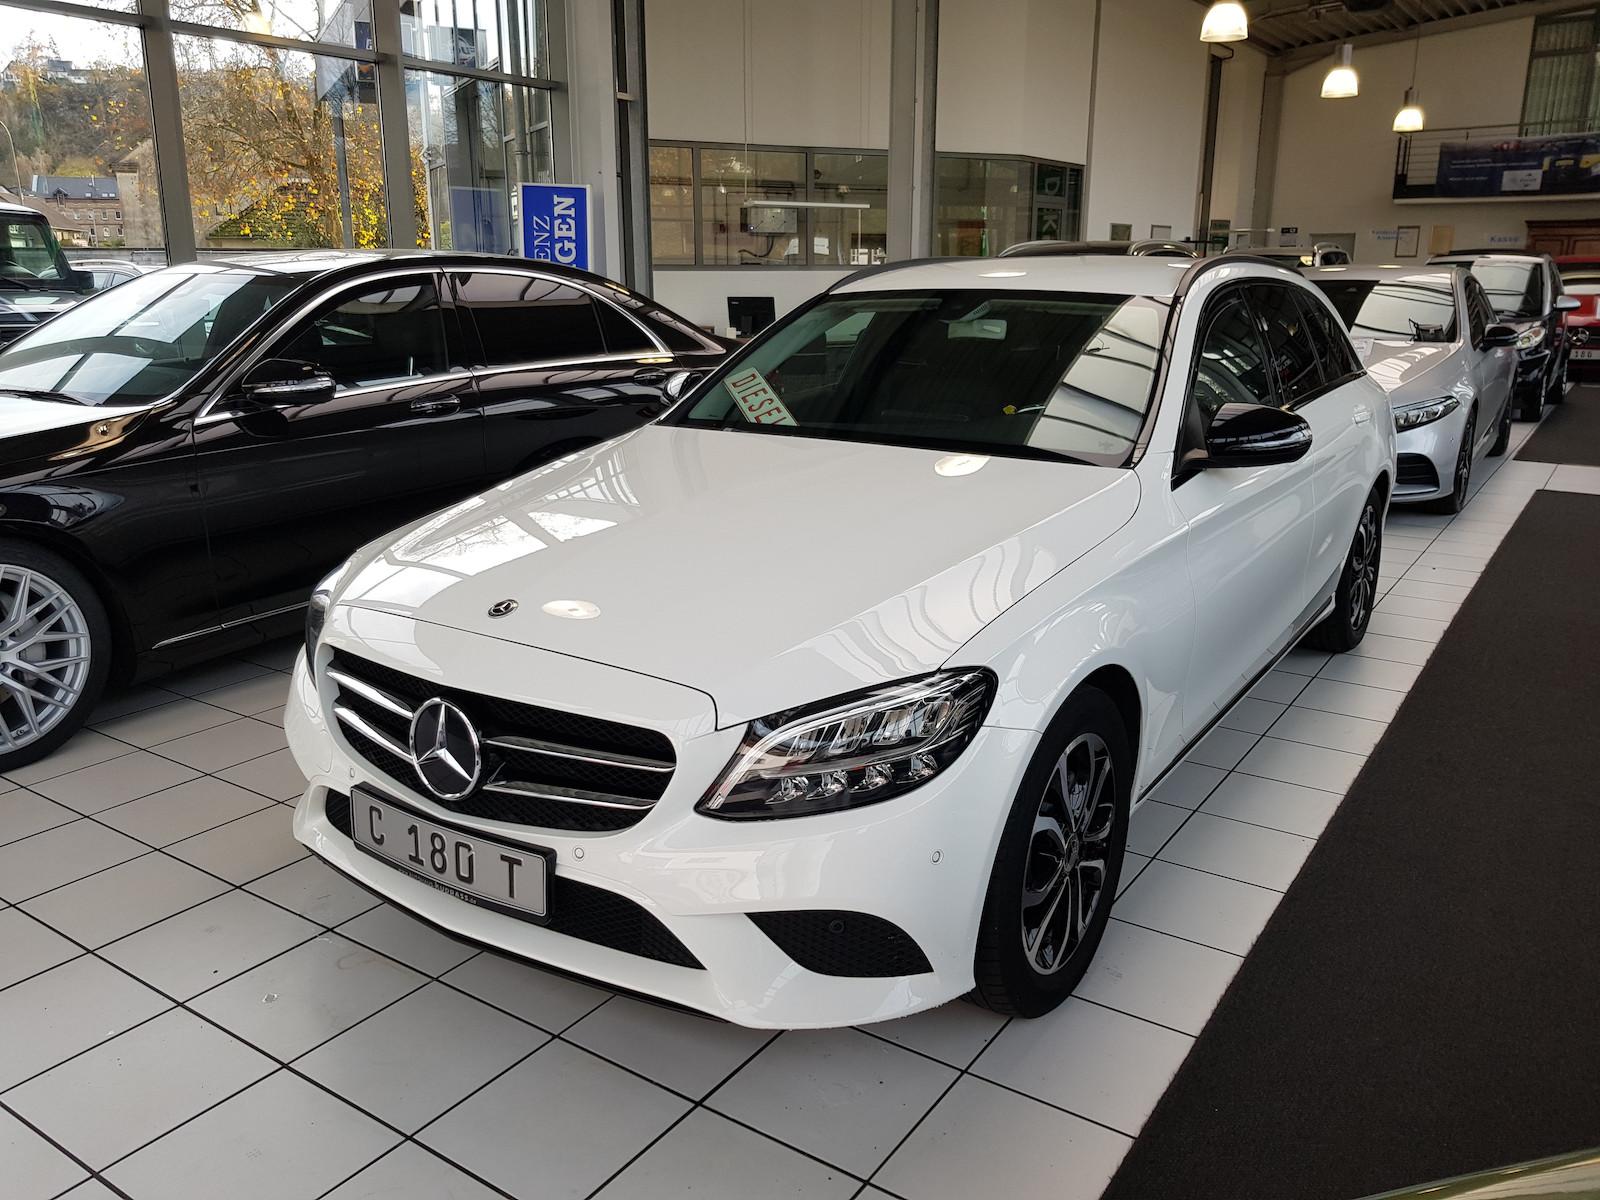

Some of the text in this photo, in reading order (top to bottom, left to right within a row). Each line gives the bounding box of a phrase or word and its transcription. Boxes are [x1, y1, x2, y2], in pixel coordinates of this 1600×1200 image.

[553, 194, 576, 268] GEN
[369, 804, 385, 846] C
[408, 823, 475, 885] 180
[500, 854, 523, 899] T
